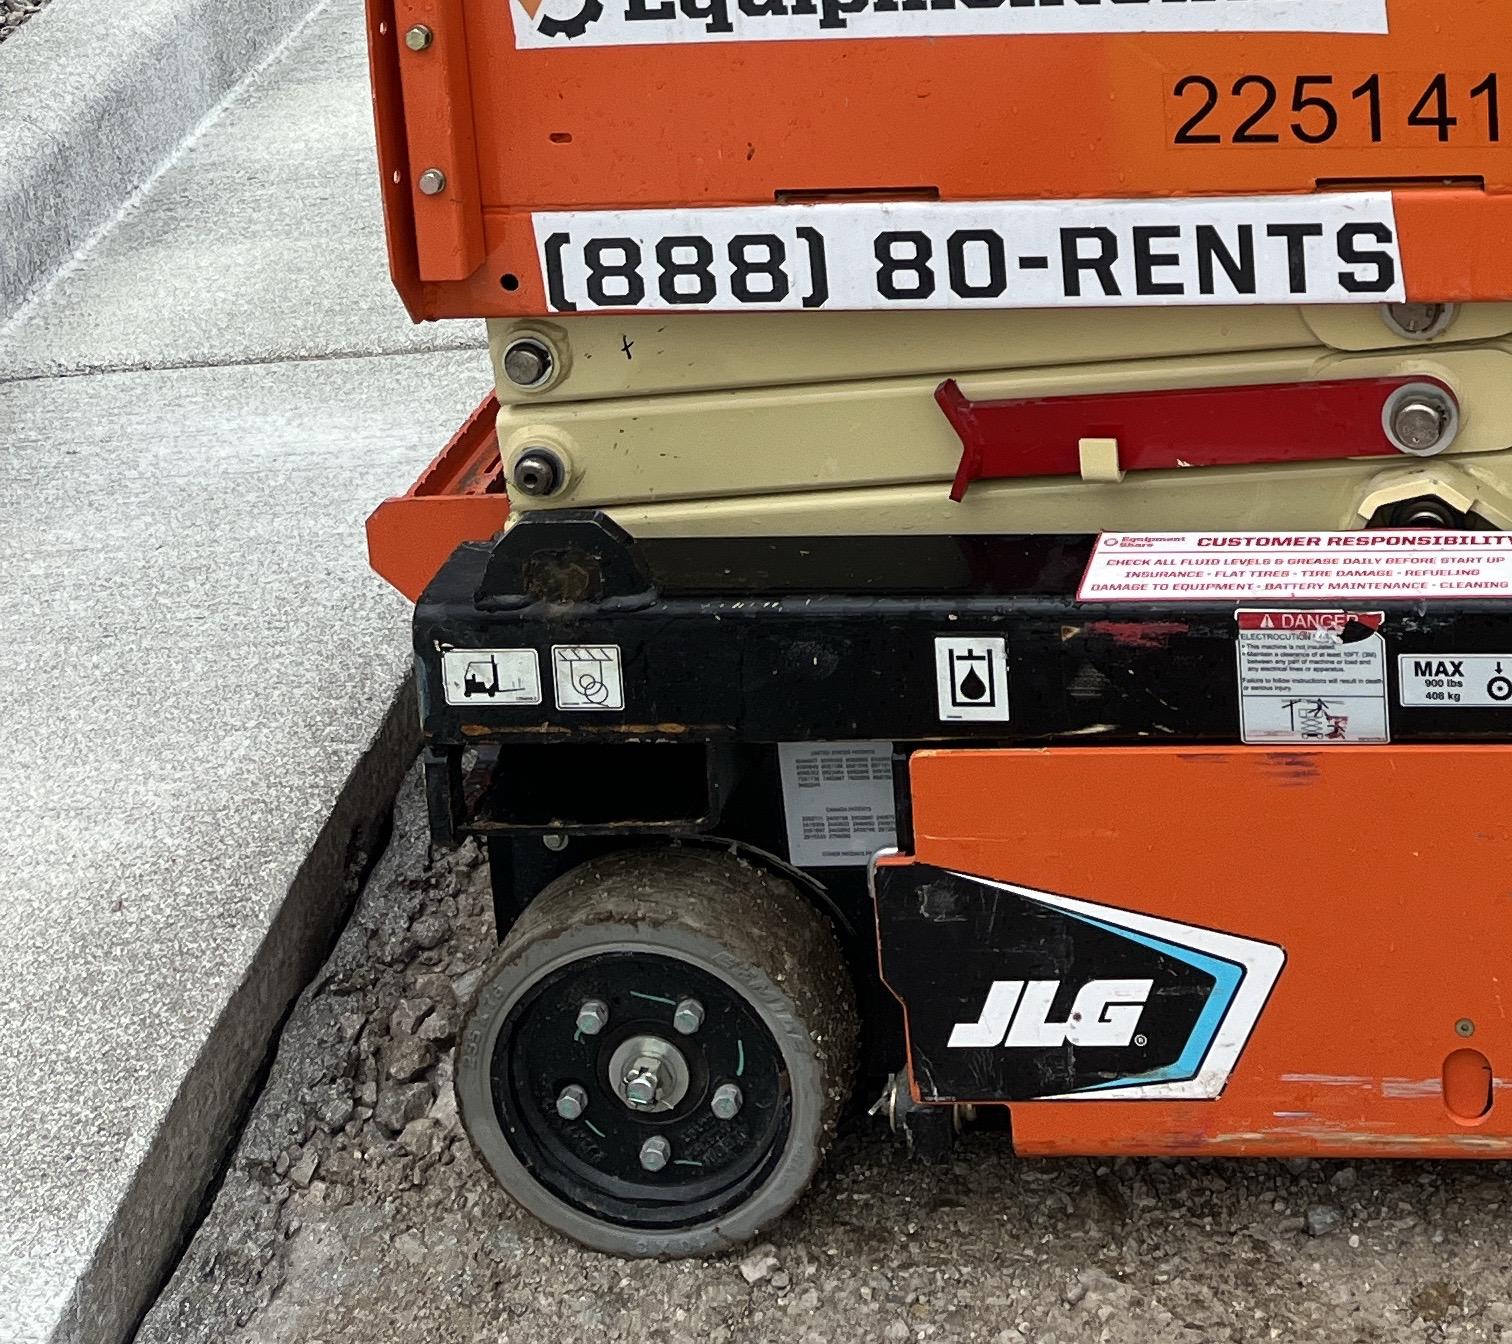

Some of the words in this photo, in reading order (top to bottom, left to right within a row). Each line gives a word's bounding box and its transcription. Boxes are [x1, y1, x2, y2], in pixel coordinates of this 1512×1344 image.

[1173, 72, 1500, 145] 225141
[545, 227, 829, 311] (888)
[875, 223, 1399, 301] 80-RENTS
[1197, 536, 1321, 547] CUSTOMER
[1106, 558, 1151, 566] CHECK
[1154, 558, 1175, 566] ALL
[1180, 558, 1220, 566] FLUID
[1223, 558, 1270, 566] LEVELS
[1274, 558, 1284, 566] &
[1287, 558, 1340, 566] GREASE
[1343, 558, 1382, 566] DAILY
[1124, 570, 1204, 578] INSURANCE
[1214, 570, 1246, 578] FLAT
[1249, 570, 1290, 578] TIRES
[1301, 570, 1333, 578] TIRE
[1336, 569, 1394, 577] DAMAGE
[1404, 569, 1481, 577] REFUELING
[1091, 583, 1149, 592] DAMAGE
[1152, 583, 1169, 591] TO
[1172, 583, 1255, 591] EQUIPMENT
[1264, 582, 1325, 590] BATTERY
[1328, 582, 1429, 591] MAINTENANCE
[1439, 581, 1509, 589] CLEANING
[1414, 661, 1465, 677] MAX
[1425, 679, 1444, 688] 900
[1447, 679, 1463, 688] lbs
[1426, 692, 1444, 701] 408
[1448, 692, 1461, 702] kg
